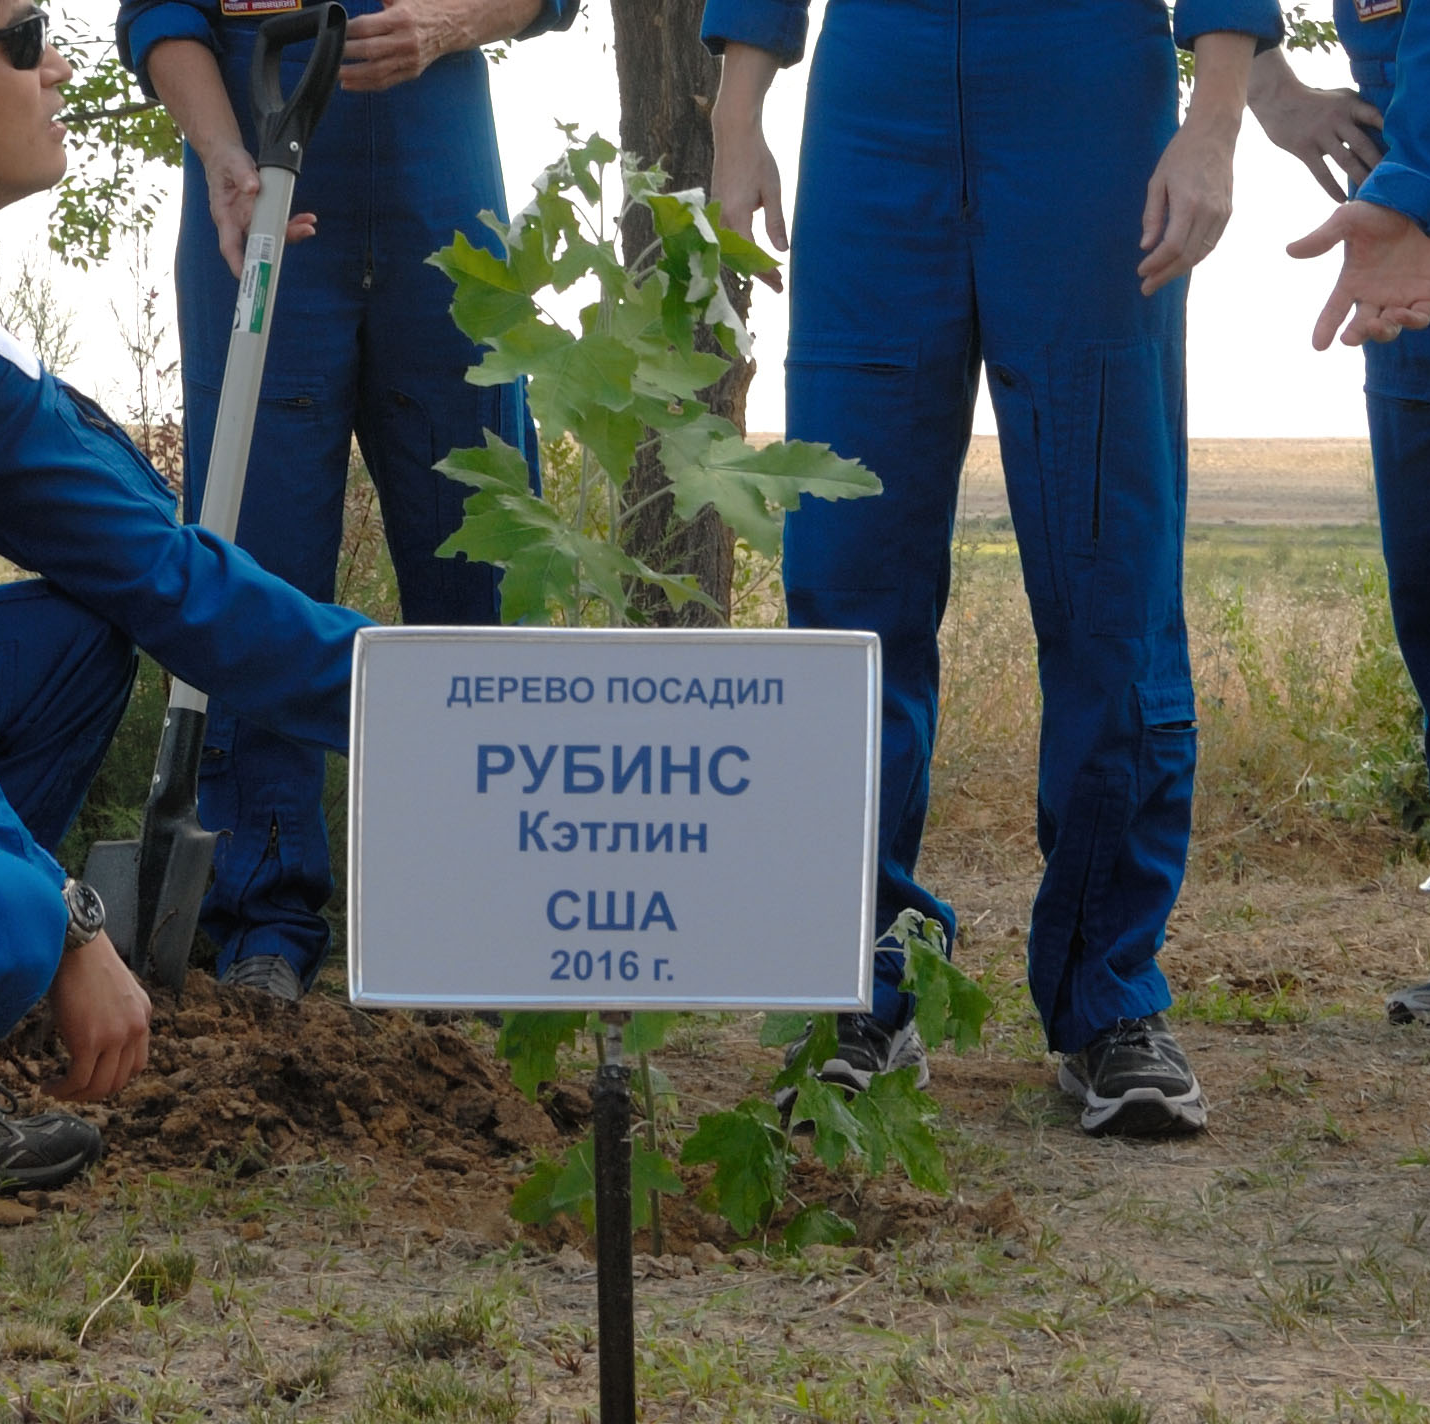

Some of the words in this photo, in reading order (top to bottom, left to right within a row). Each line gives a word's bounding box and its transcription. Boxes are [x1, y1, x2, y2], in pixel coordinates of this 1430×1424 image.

[446, 675, 595, 708] ДЕРЕВО
[607, 677, 784, 710] ПОСАДИЛ
[476, 744, 751, 796] РУБИНС
[518, 810, 708, 854] Кэтлин
[546, 889, 678, 932] США
[550, 949, 640, 982] 2016
[653, 958, 674, 982] г.
